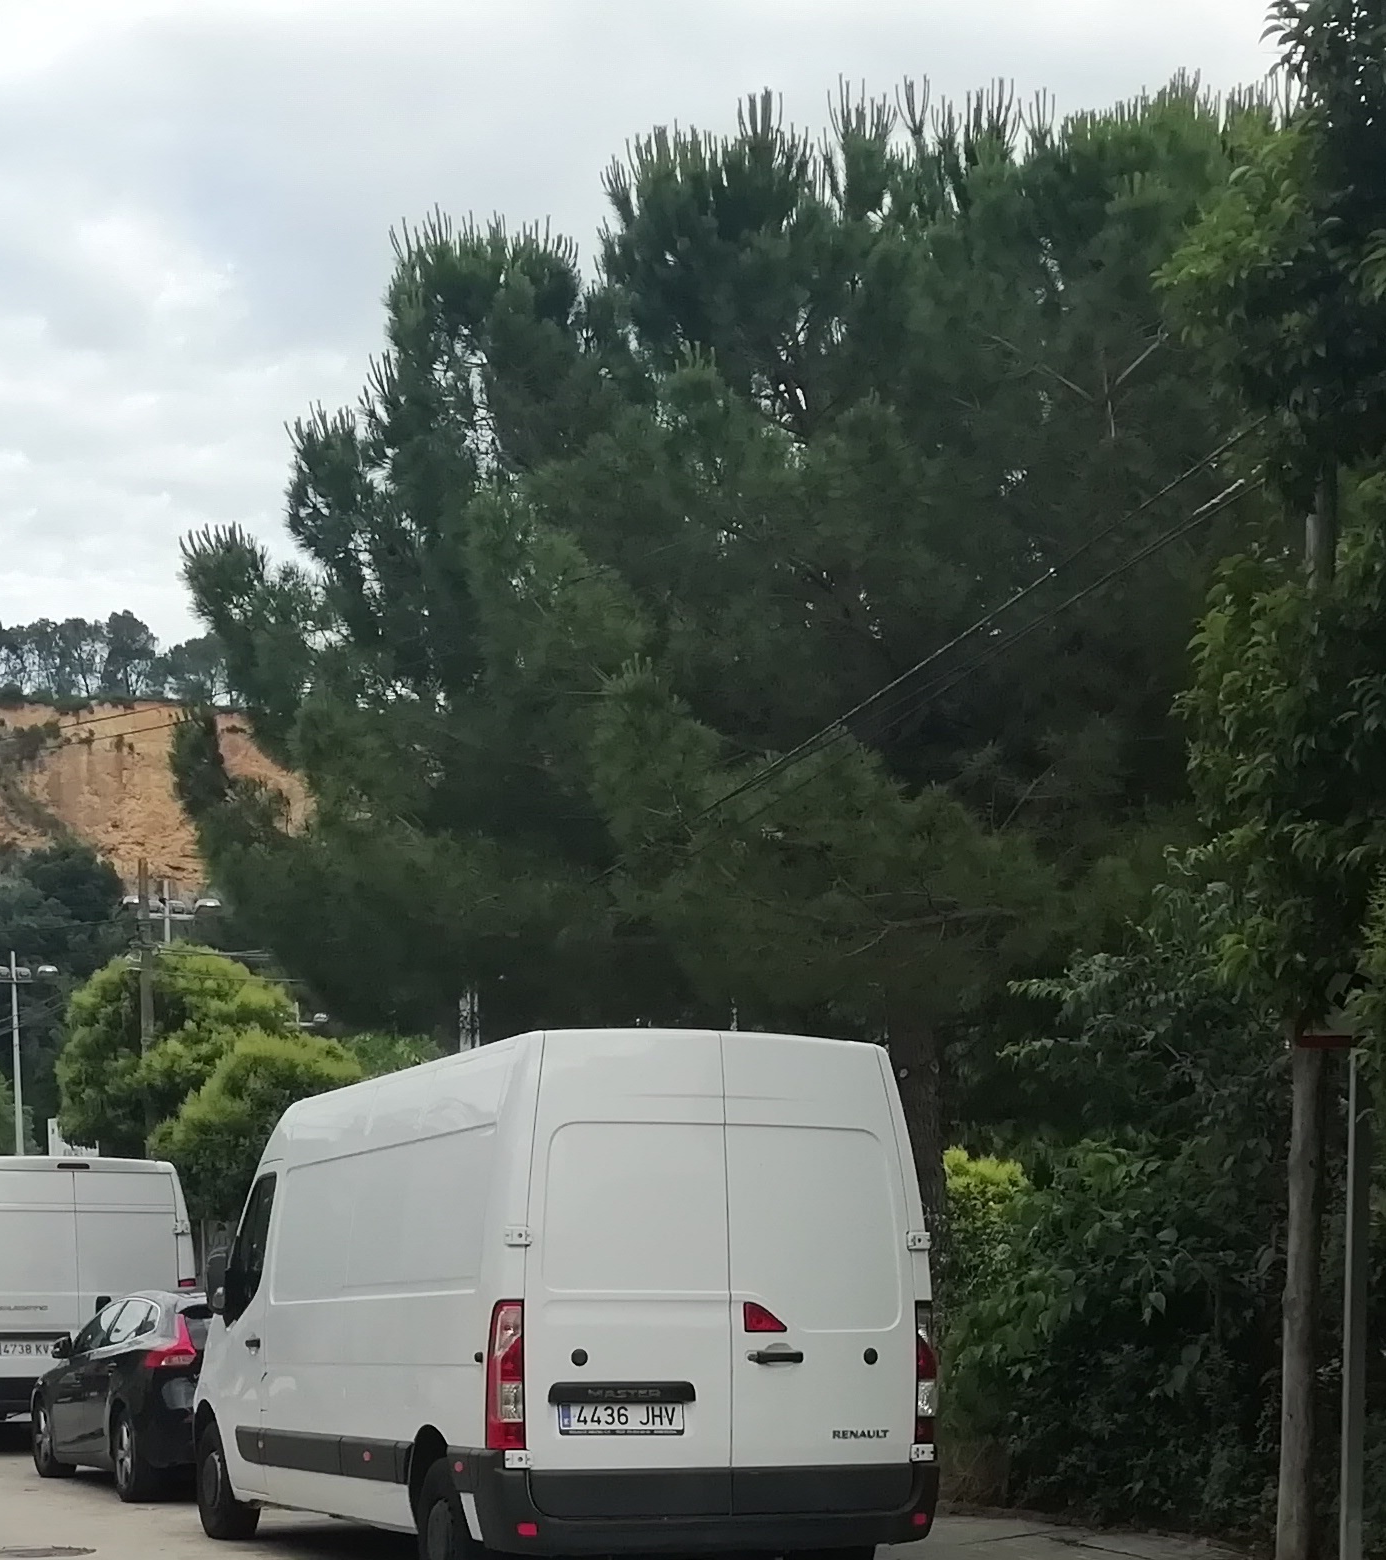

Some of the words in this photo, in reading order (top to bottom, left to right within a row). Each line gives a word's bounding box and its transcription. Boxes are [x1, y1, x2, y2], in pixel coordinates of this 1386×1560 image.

[3, 1343, 32, 1355] 4738
[35, 1343, 54, 1355] KV
[587, 1388, 662, 1399] MASTER
[576, 1405, 629, 1426] 4436
[639, 1405, 676, 1426] JHV
[832, 1429, 890, 1440] RENAULT
